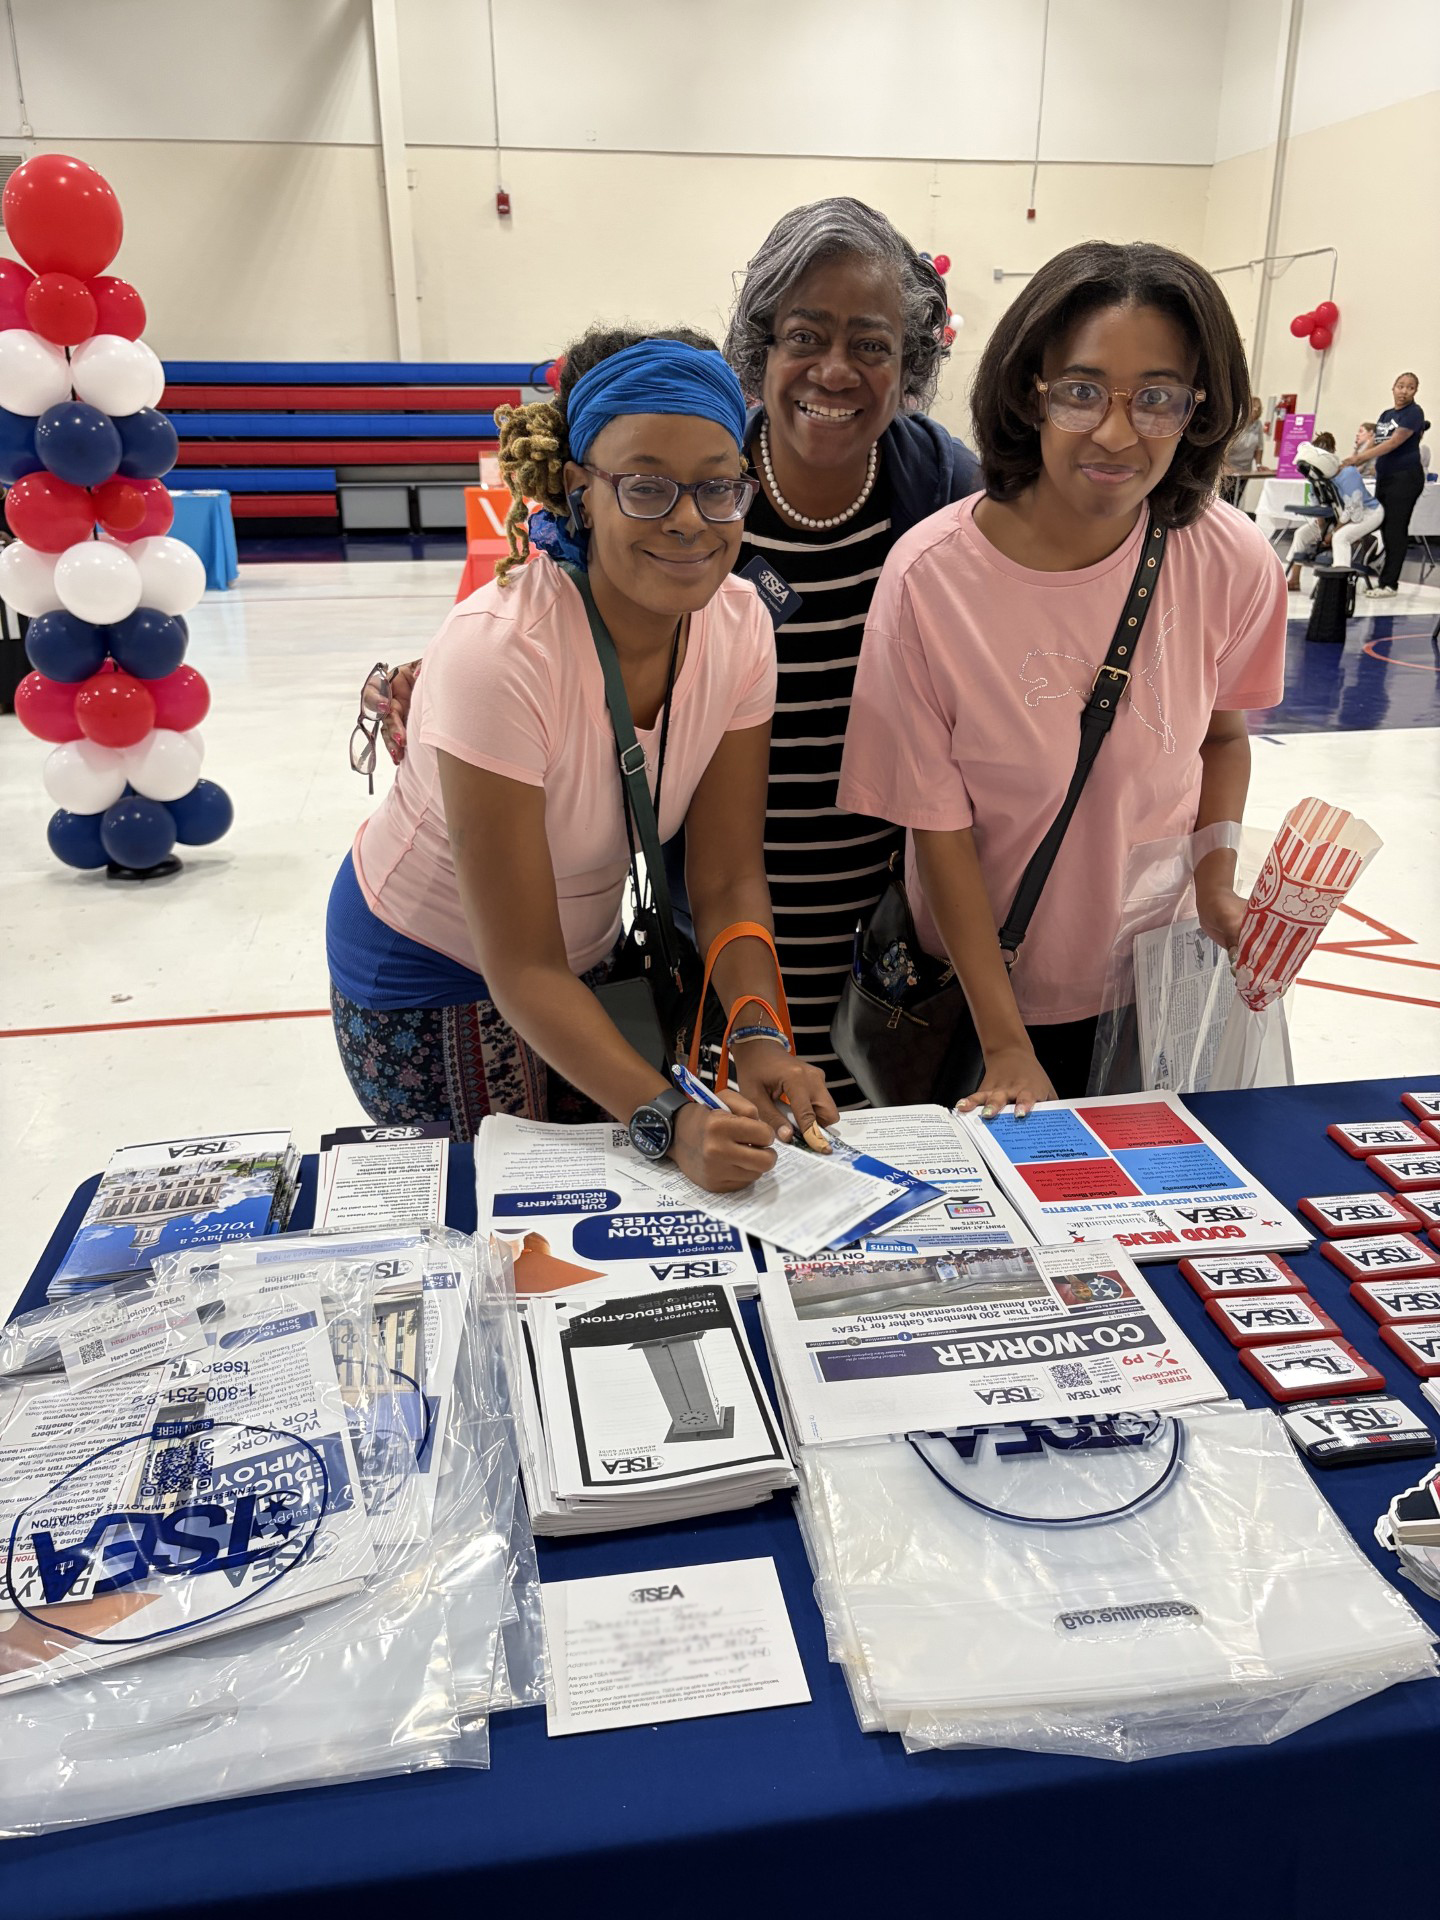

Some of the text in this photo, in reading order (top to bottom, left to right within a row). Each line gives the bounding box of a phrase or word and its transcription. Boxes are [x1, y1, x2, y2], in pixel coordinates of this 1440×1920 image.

[763, 570, 790, 604] TSEA
[1264, 857, 1274, 878] OP
[361, 1127, 415, 1140] TSEA
[1348, 1131, 1413, 1144] TSEA
[168, 1141, 232, 1158] TSEA
[634, 1134, 654, 1152] 11:49
[517, 1198, 607, 1208] ACHIEVEMENTS
[552, 1192, 607, 1200] INCLUDE:
[1131, 1197, 1192, 1207] ACCEPTANCE
[1193, 1192, 1257, 1203] GUARANTEED
[1041, 1204, 1092, 1215] BENEFITS
[1094, 1202, 1112, 1210] ALL
[1319, 1205, 1392, 1221] TSEA
[611, 1214, 718, 1227] MPLOYEES
[1177, 1206, 1252, 1223] TSEA
[174, 1220, 255, 1234] voice...
[608, 1223, 731, 1238] EDUCATION
[949, 1224, 1006, 1232] PRINT-AT-HOME
[191, 1233, 222, 1244] have
[227, 1232, 252, 1241] You
[652, 1232, 732, 1246] HIGHER
[1112, 1225, 1246, 1246] GOOD NEWS
[677, 1245, 714, 1254] support
[870, 1244, 913, 1252] BENEFITS
[782, 1254, 839, 1262] TICKETS
[1345, 1247, 1420, 1266] TSEA
[649, 1261, 728, 1281] TSEA
[1199, 1268, 1277, 1286] TSEA
[157, 1294, 186, 1309] TSEA?
[1032, 1304, 1060, 1313] More
[580, 1299, 716, 1324] HIGHER EDUCATION
[654, 1311, 696, 1322] SUPPORTS
[856, 1298, 1055, 1323] 52nd Annual Representative Assembly
[1228, 1308, 1309, 1327] TSEA
[280, 1317, 300, 1326] Join
[888, 1320, 924, 1329] Gather
[927, 1313, 977, 1324] Members
[276, 1323, 301, 1331] Scan
[832, 1325, 867, 1333] TSEA's
[111, 1338, 167, 1362] Have Questions?
[932, 1323, 1145, 1366] CO-WORKER
[1121, 1353, 1142, 1365] P9
[288, 1369, 310, 1377] across
[1132, 1368, 1187, 1382] LUNCHEONS
[1156, 1374, 1192, 1385] RETIREE
[271, 1374, 311, 1388] recognized
[278, 1385, 313, 1398] Education
[974, 1386, 1035, 1405] TSEA
[1067, 1385, 1122, 1400] Join TSEA!
[284, 1401, 301, 1409] TSEA
[120, 1420, 142, 1428] TSEA
[282, 1408, 318, 1426] FOR
[1303, 1407, 1398, 1435] TSEA
[35, 1422, 73, 1431] benefits:
[156, 1421, 211, 1436] SCAN HERE
[230, 1420, 321, 1454] WE WORK
[601, 1457, 658, 1474] TSEA
[202, 1485, 256, 1501] TENNESSEE
[168, 1498, 199, 1507] STATE
[30, 1507, 103, 1529] ASSOCIATION
[30, 1493, 275, 1604] TSEA
[638, 1584, 685, 1604] TSEA
